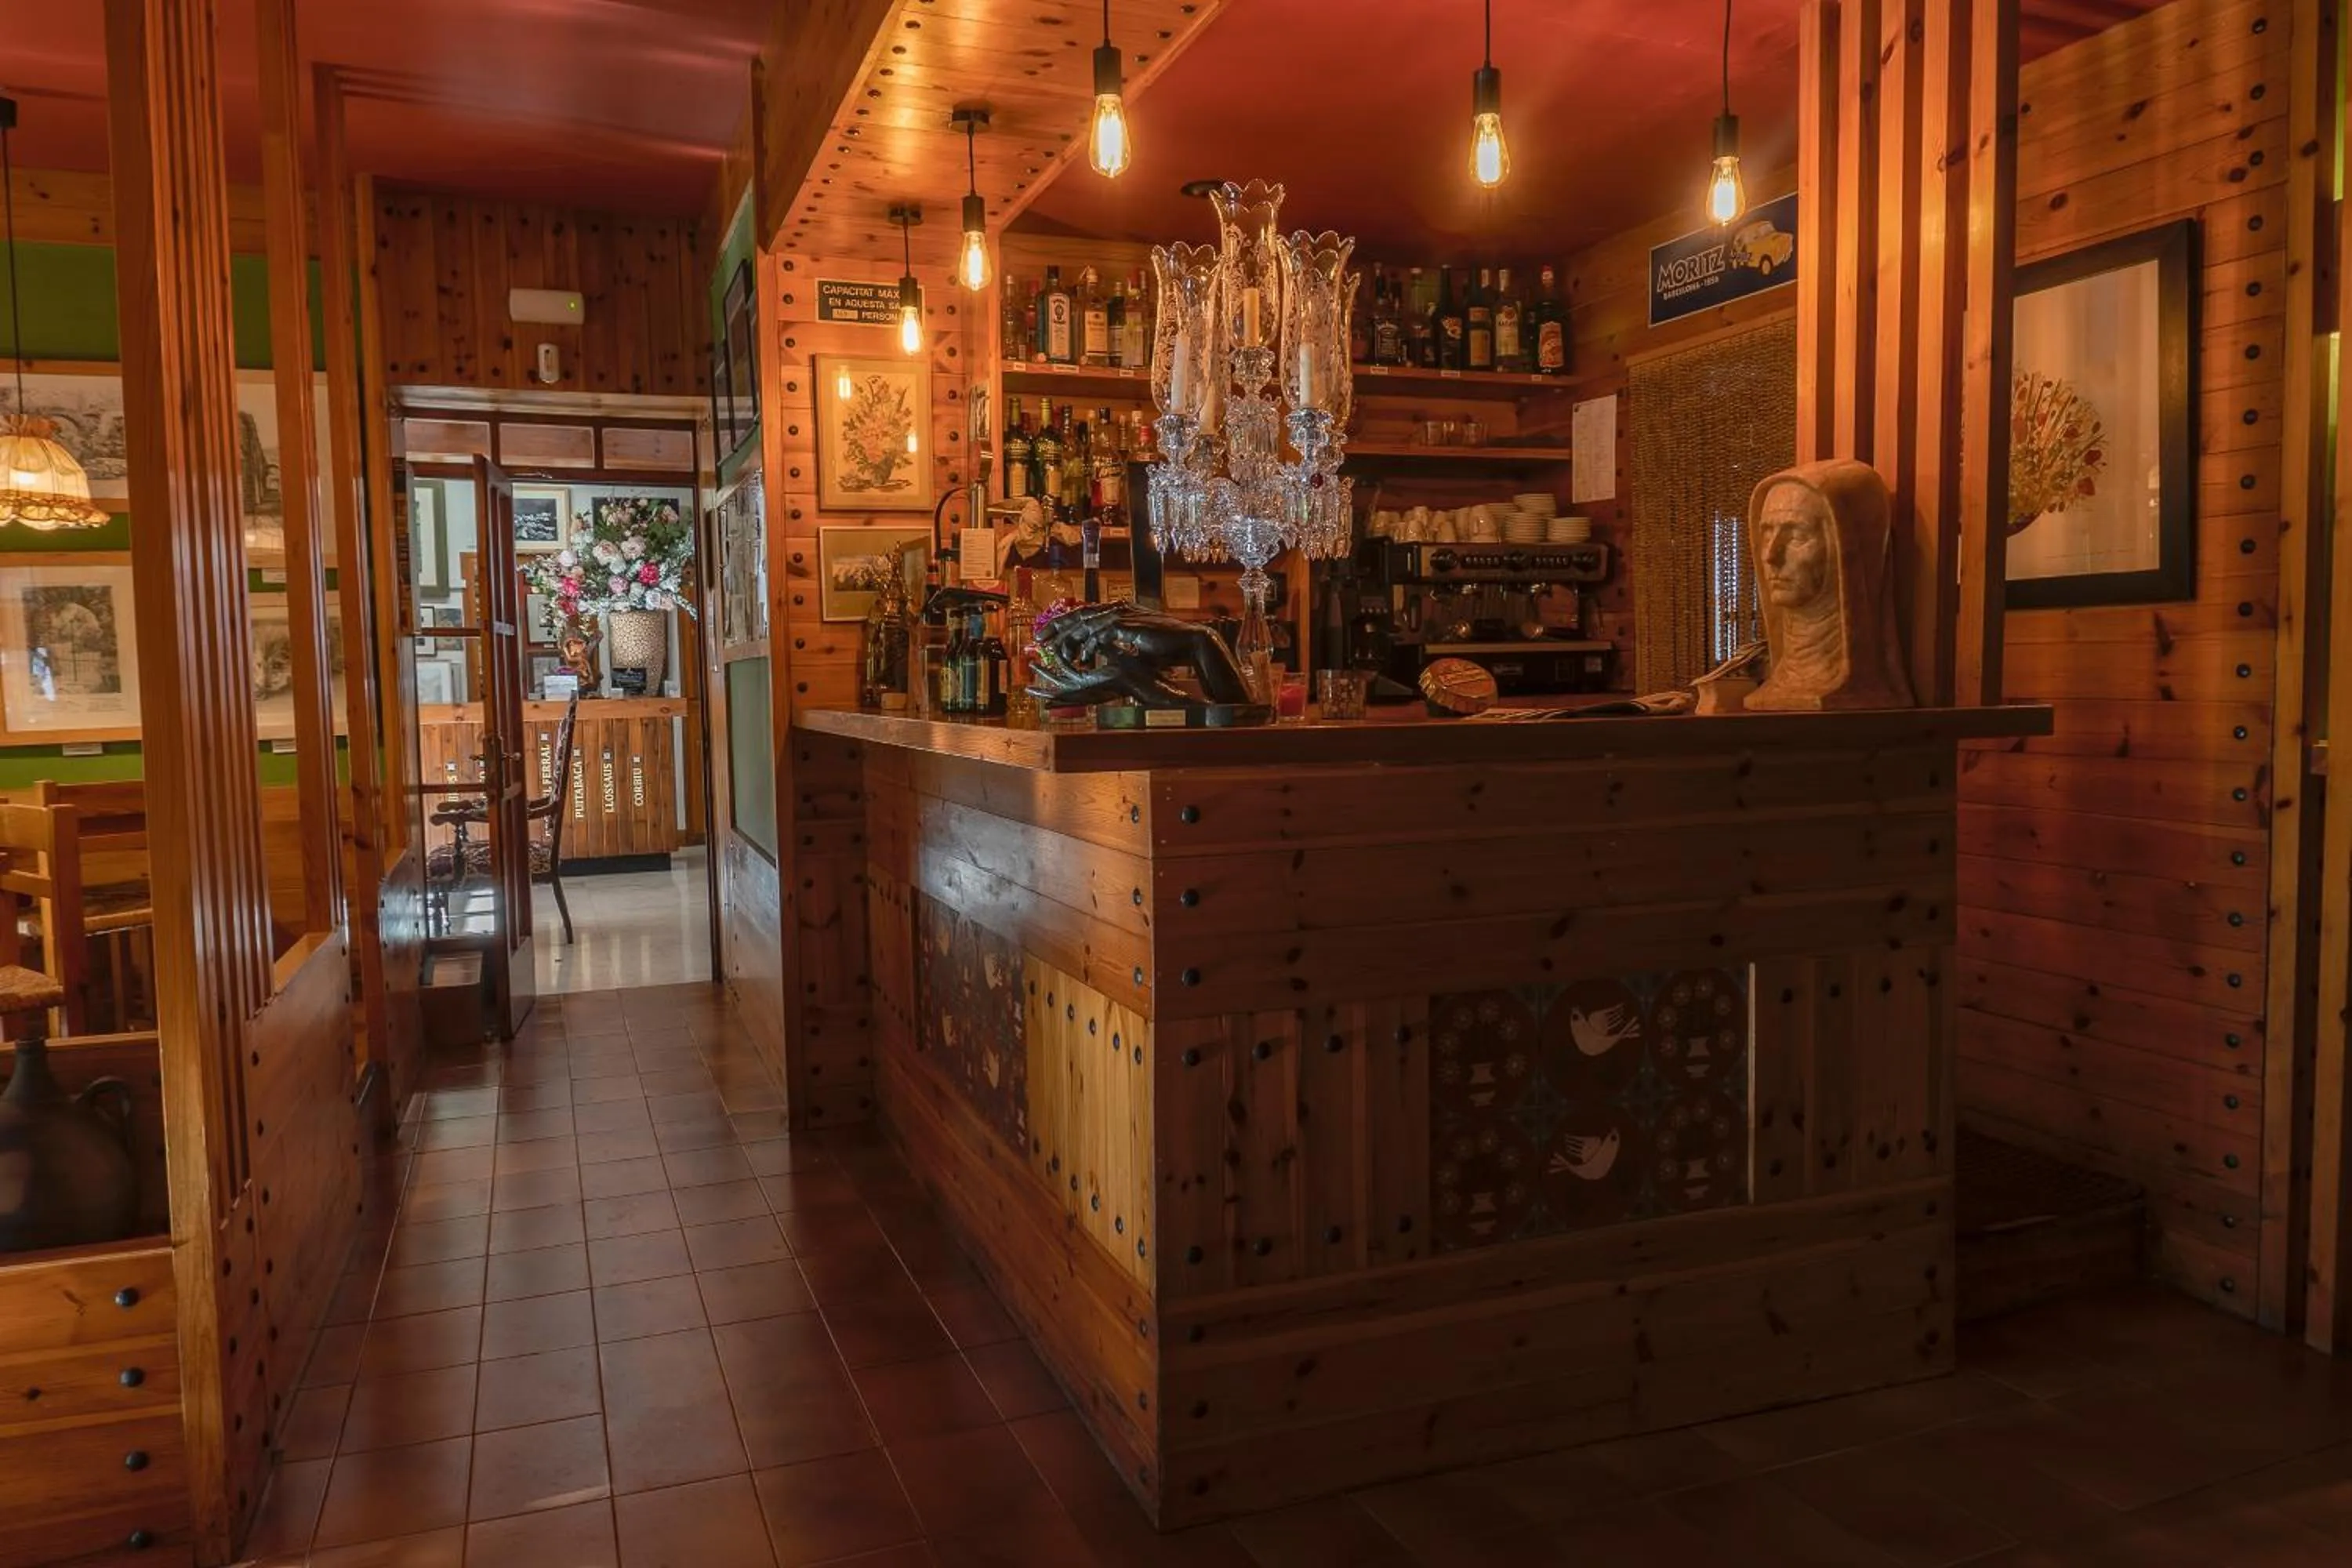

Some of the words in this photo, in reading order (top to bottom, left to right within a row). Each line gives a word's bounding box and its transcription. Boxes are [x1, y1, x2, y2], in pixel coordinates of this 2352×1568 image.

[1657, 245, 1725, 292] MORITZ
[822, 285, 873, 297] CAPACITAT
[829, 297, 841, 307] EN
[844, 299, 885, 310] AQUESTA
[888, 302, 901, 310] SA
[862, 311, 898, 321] PERSON
